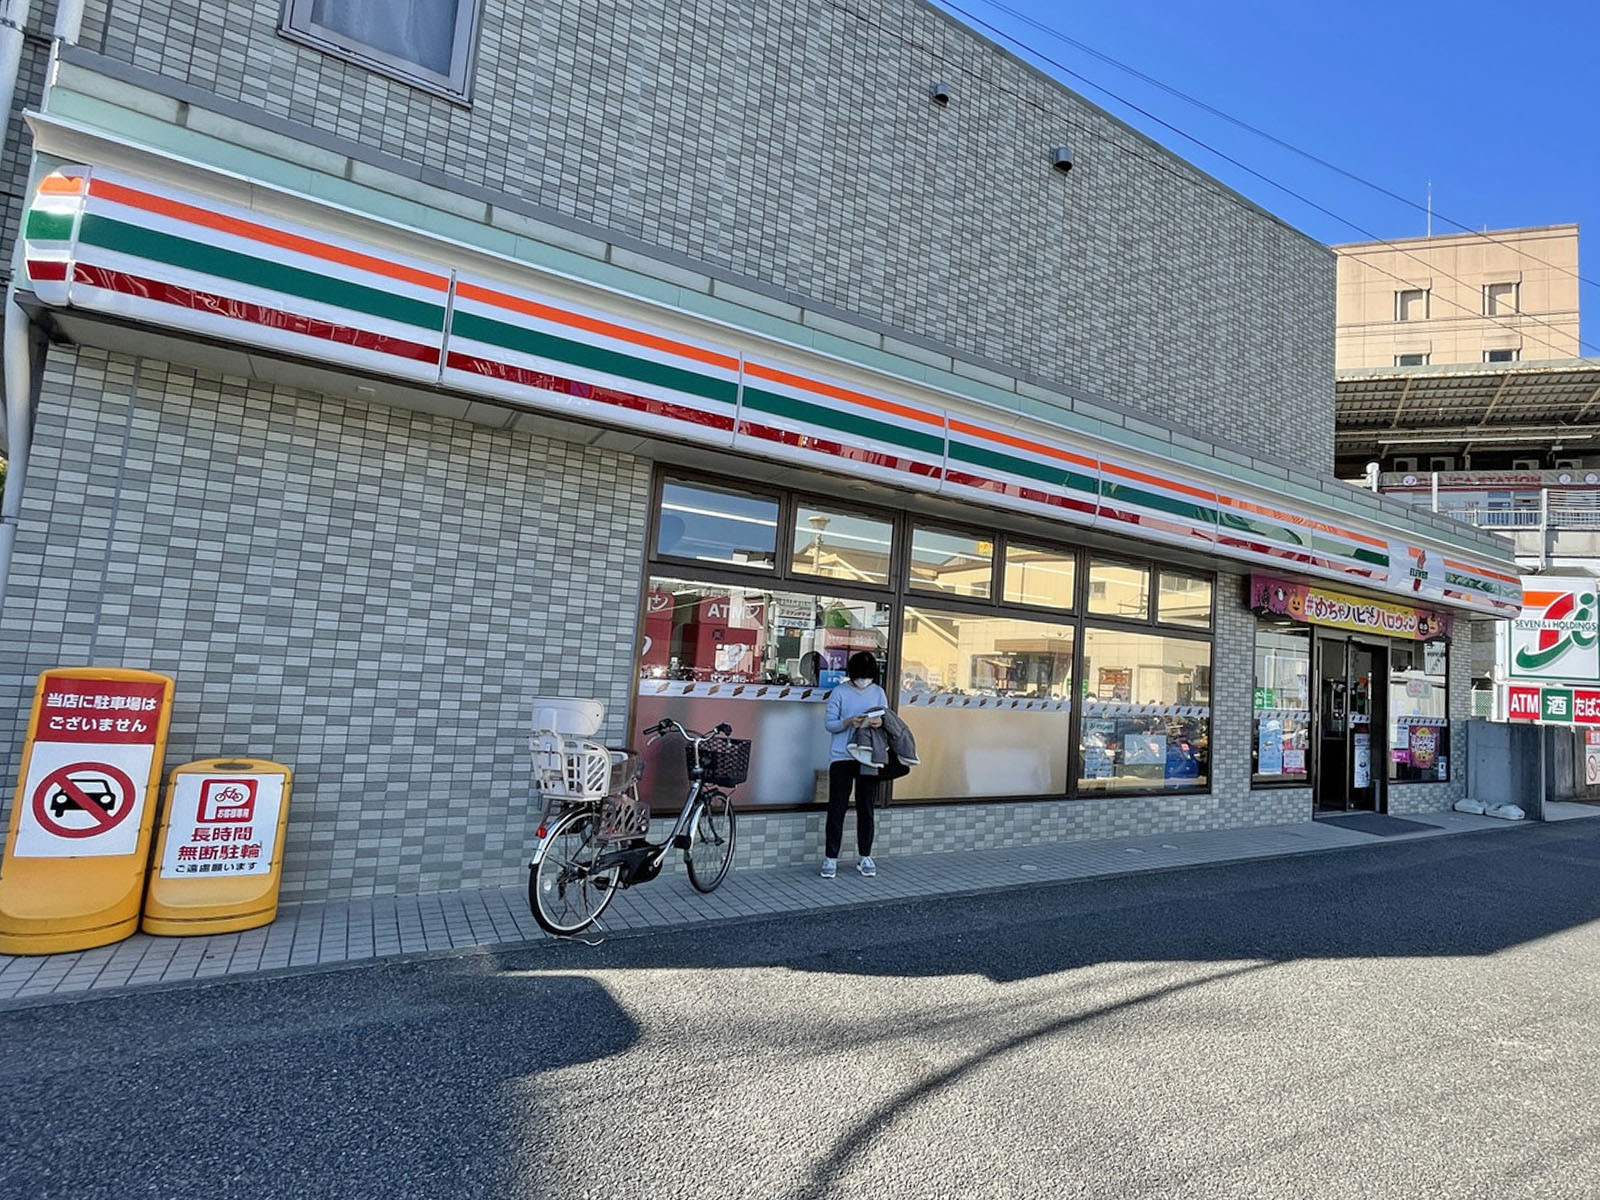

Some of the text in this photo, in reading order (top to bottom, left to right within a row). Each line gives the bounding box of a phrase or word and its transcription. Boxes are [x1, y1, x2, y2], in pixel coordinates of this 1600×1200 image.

[1553, 620, 1597, 631] HOLDINGS
[46, 693, 157, 711] 当店に駐車場は
[1511, 693, 1539, 713] ATM
[1547, 696, 1568, 714] 酒
[49, 716, 147, 732] ございません
[191, 826, 253, 842] 長時間
[178, 843, 262, 860] 無断駐輪
[176, 862, 257, 873] ご遠慮願います
